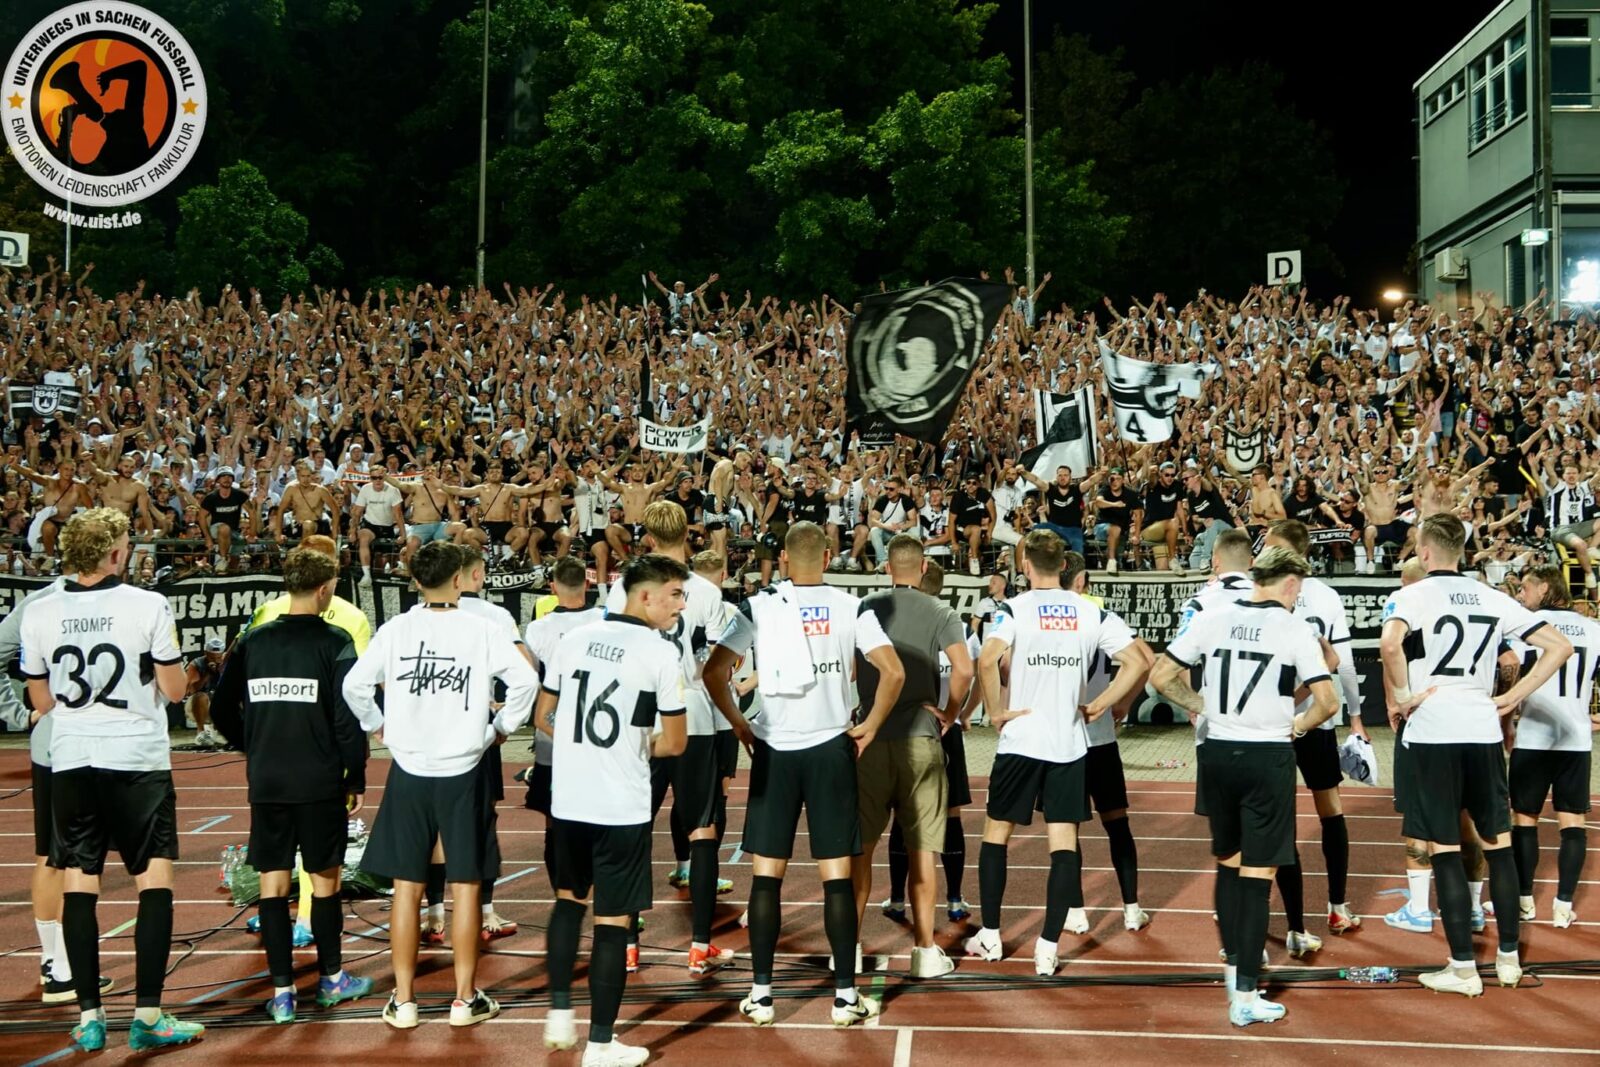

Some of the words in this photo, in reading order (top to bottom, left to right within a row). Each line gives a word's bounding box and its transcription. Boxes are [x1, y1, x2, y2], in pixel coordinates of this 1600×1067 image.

[0, 236, 20, 260] D
[1275, 257, 1293, 279] D
[645, 425, 702, 438] POWER
[1126, 412, 1148, 442] 4
[645, 434, 679, 447] ULM
[1111, 584, 1131, 598] IST
[1136, 584, 1165, 599] EINE
[1449, 593, 1480, 606] KOLBE
[1040, 604, 1077, 617] LIQUI
[1135, 598, 1167, 613] LANG
[61, 616, 114, 634] STROMPF
[1041, 617, 1077, 630] MOLY
[1147, 613, 1172, 628] RAD
[1230, 624, 1262, 642] KÖLLE
[586, 641, 625, 664] KELLER
[1430, 614, 1500, 677] 27
[52, 643, 128, 709] 32
[1212, 648, 1275, 716] 17
[251, 681, 315, 698] uhlsport
[571, 669, 621, 749] 16
